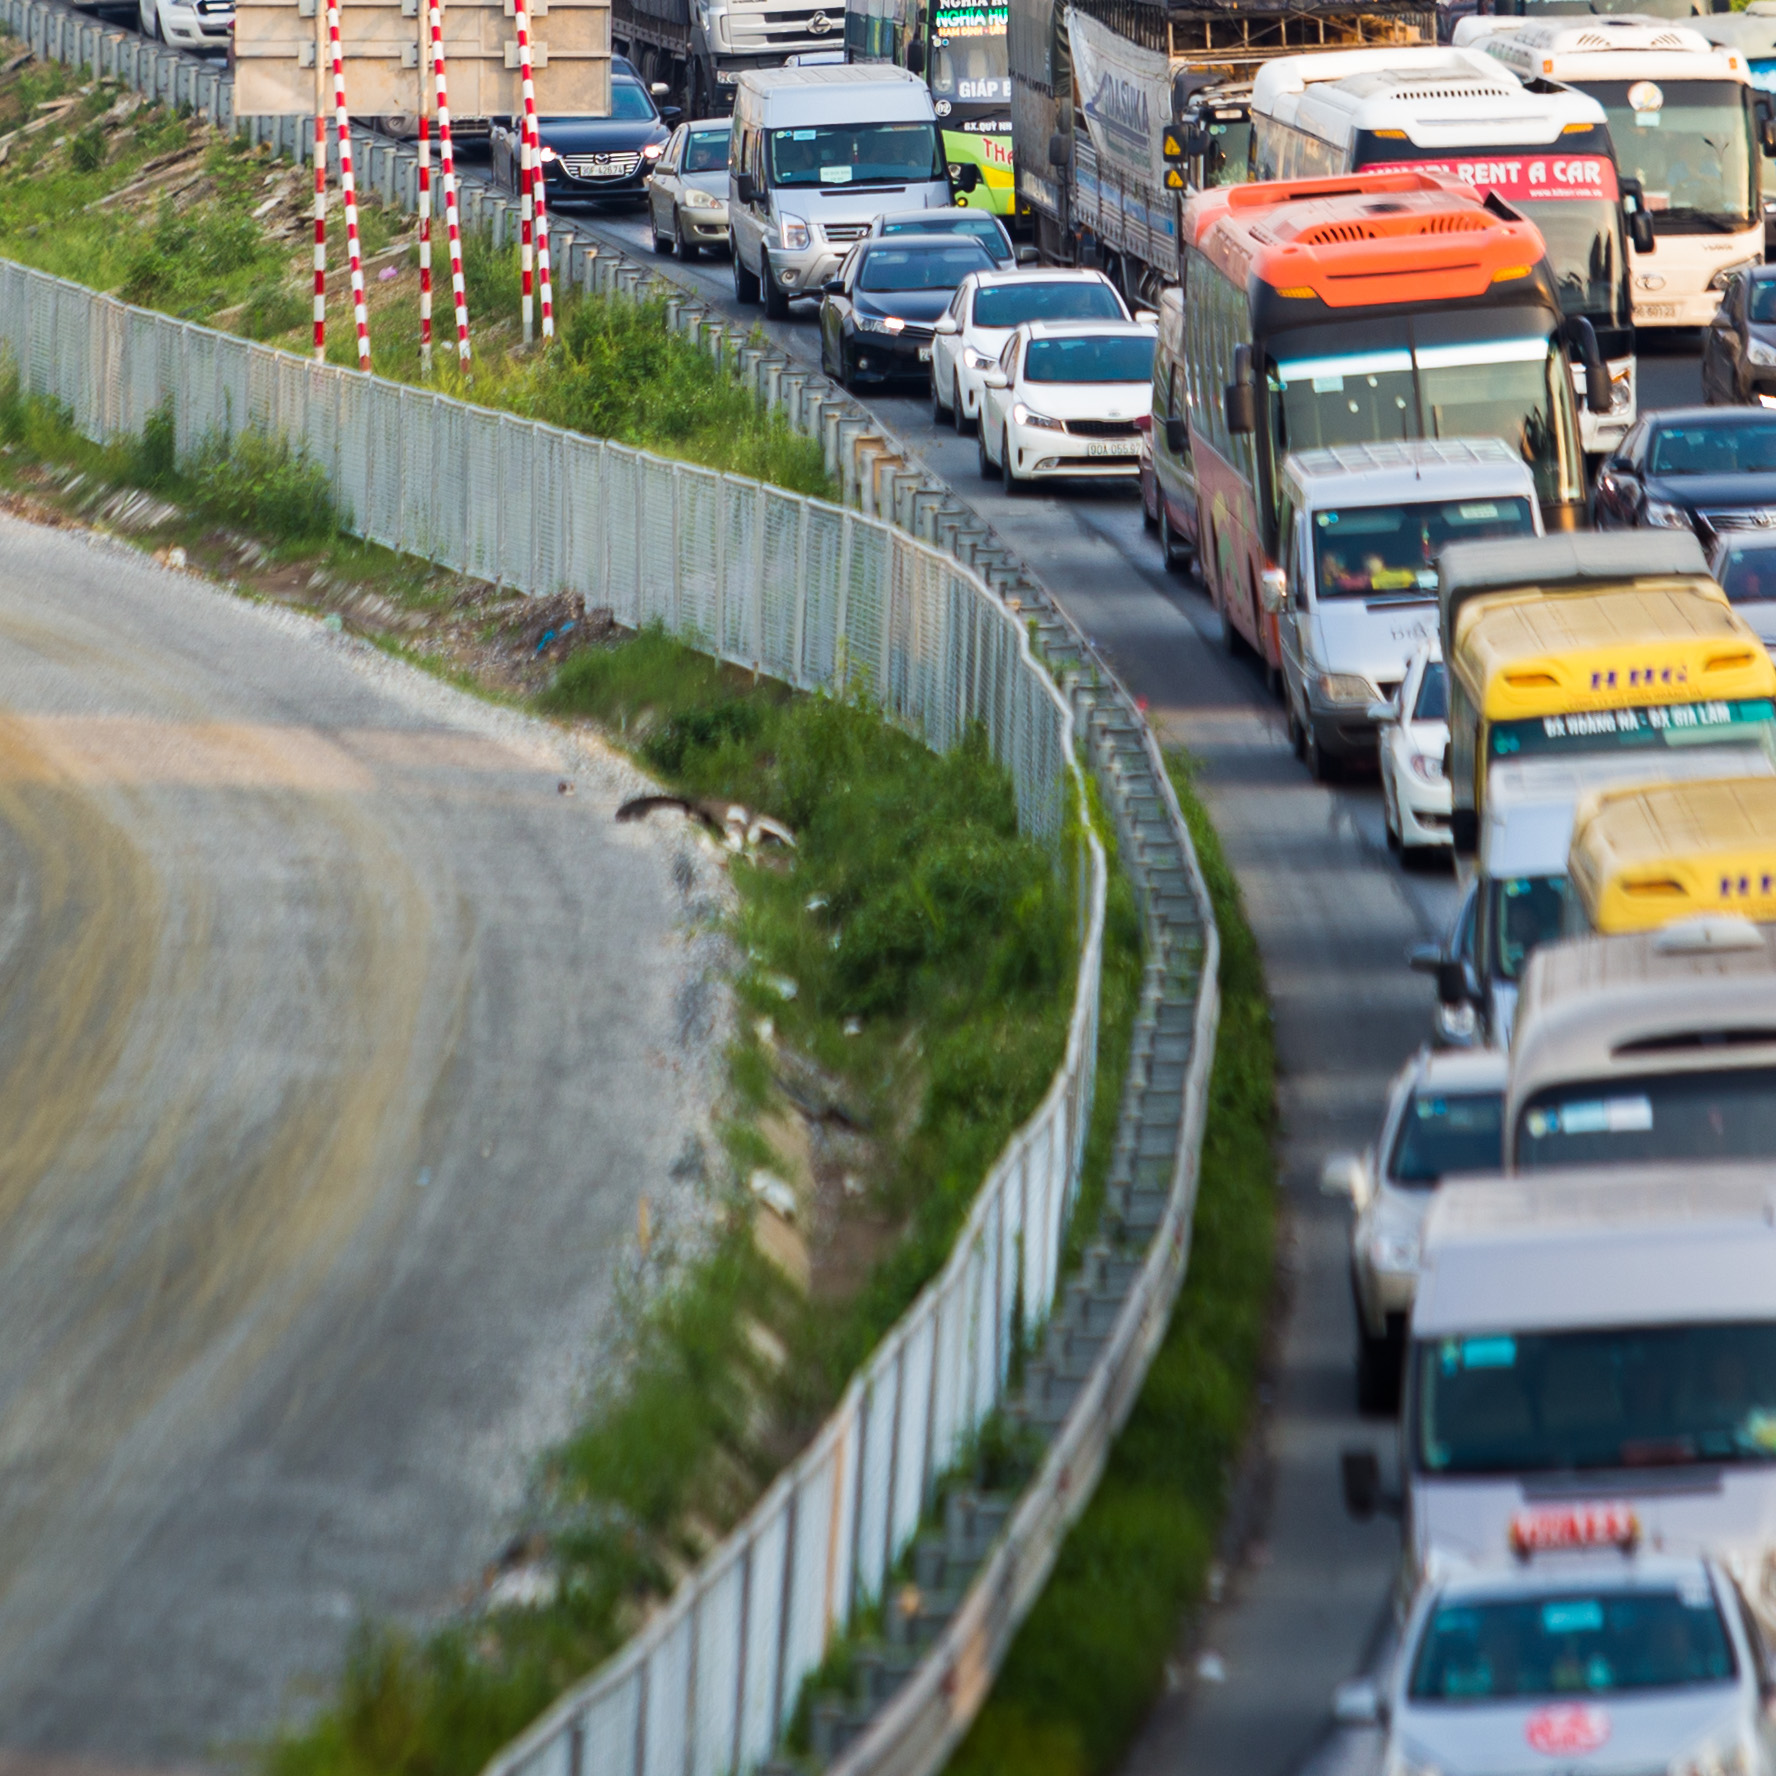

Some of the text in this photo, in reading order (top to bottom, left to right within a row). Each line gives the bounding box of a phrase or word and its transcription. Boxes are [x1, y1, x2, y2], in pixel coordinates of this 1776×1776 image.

[935, 7, 987, 28] NGHĨA
[937, 26, 960, 37] NAM
[958, 78, 999, 99] GIÁP
[1457, 160, 1602, 187] RENT A CAR
